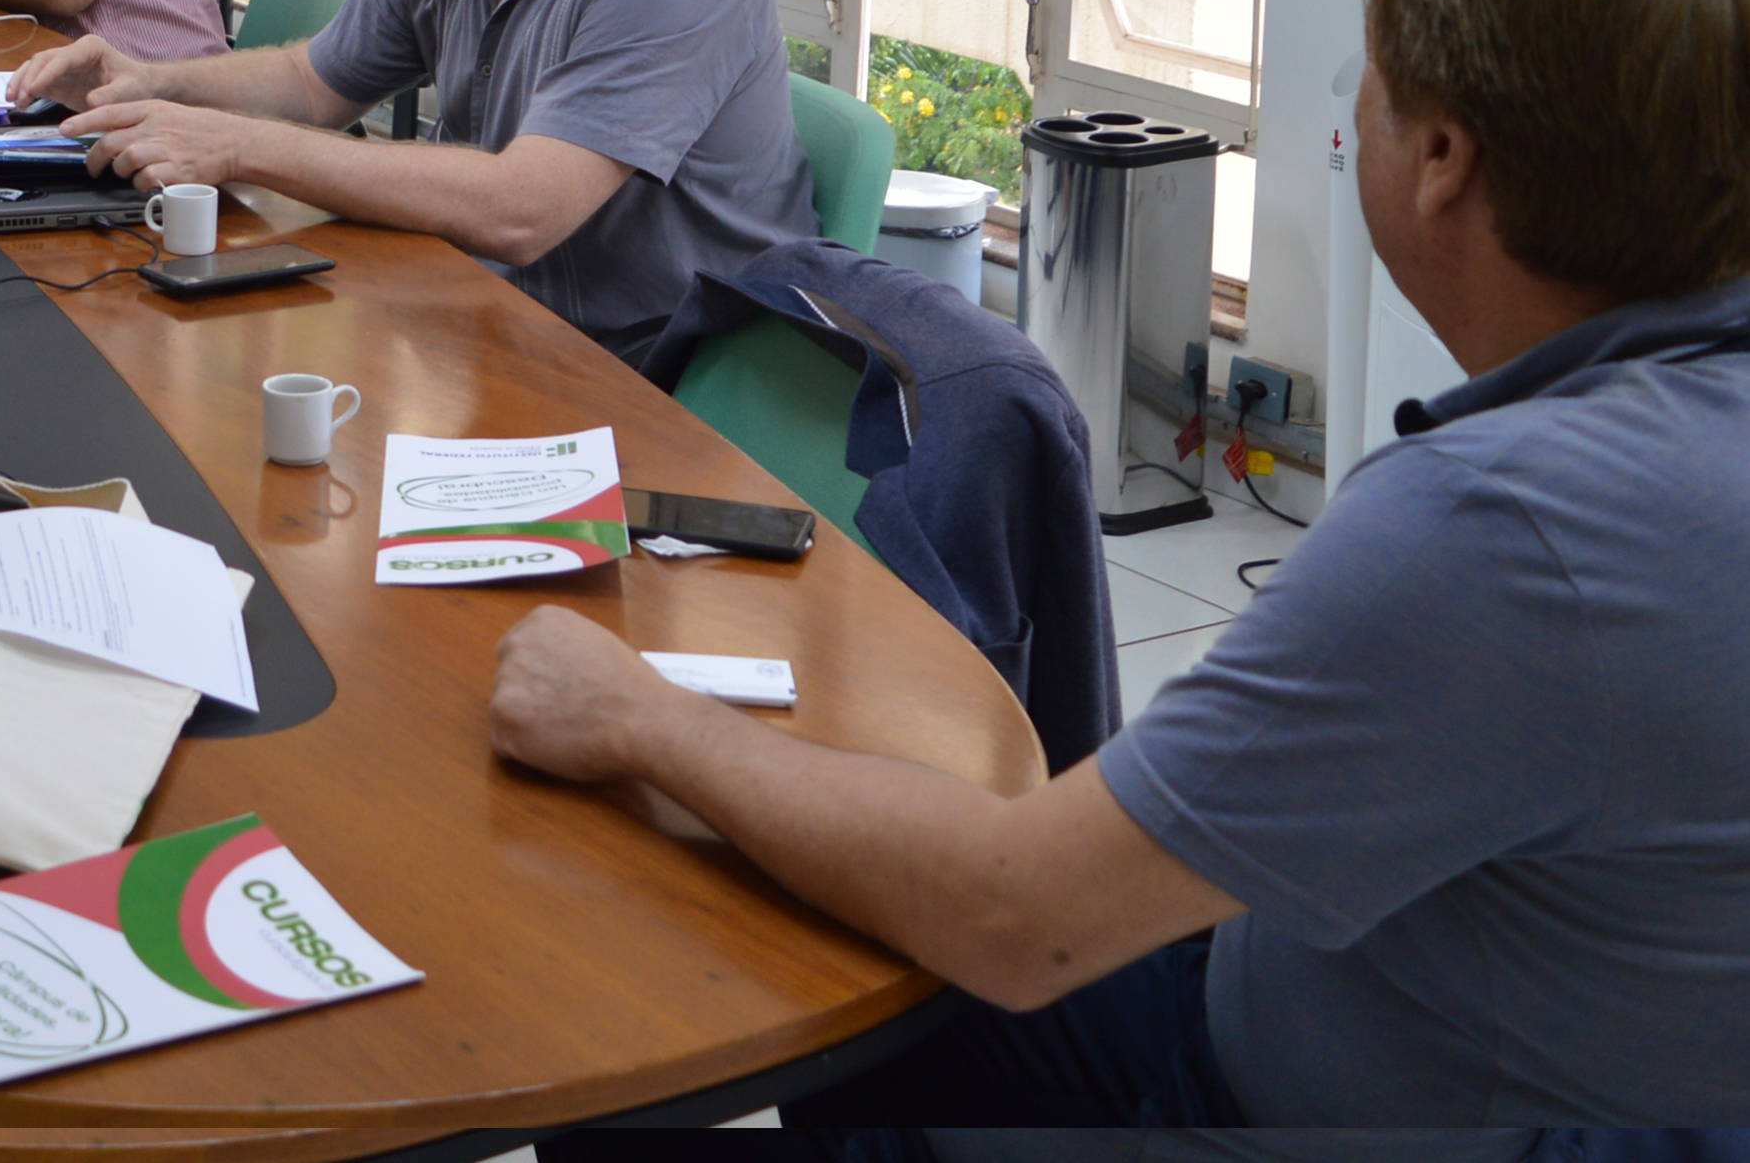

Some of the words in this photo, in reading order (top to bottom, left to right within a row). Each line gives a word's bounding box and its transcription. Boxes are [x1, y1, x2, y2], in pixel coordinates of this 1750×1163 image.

[388, 551, 555, 572] CURSOS
[241, 879, 373, 988] CURSOS
[65, 1007, 92, 1024] de
